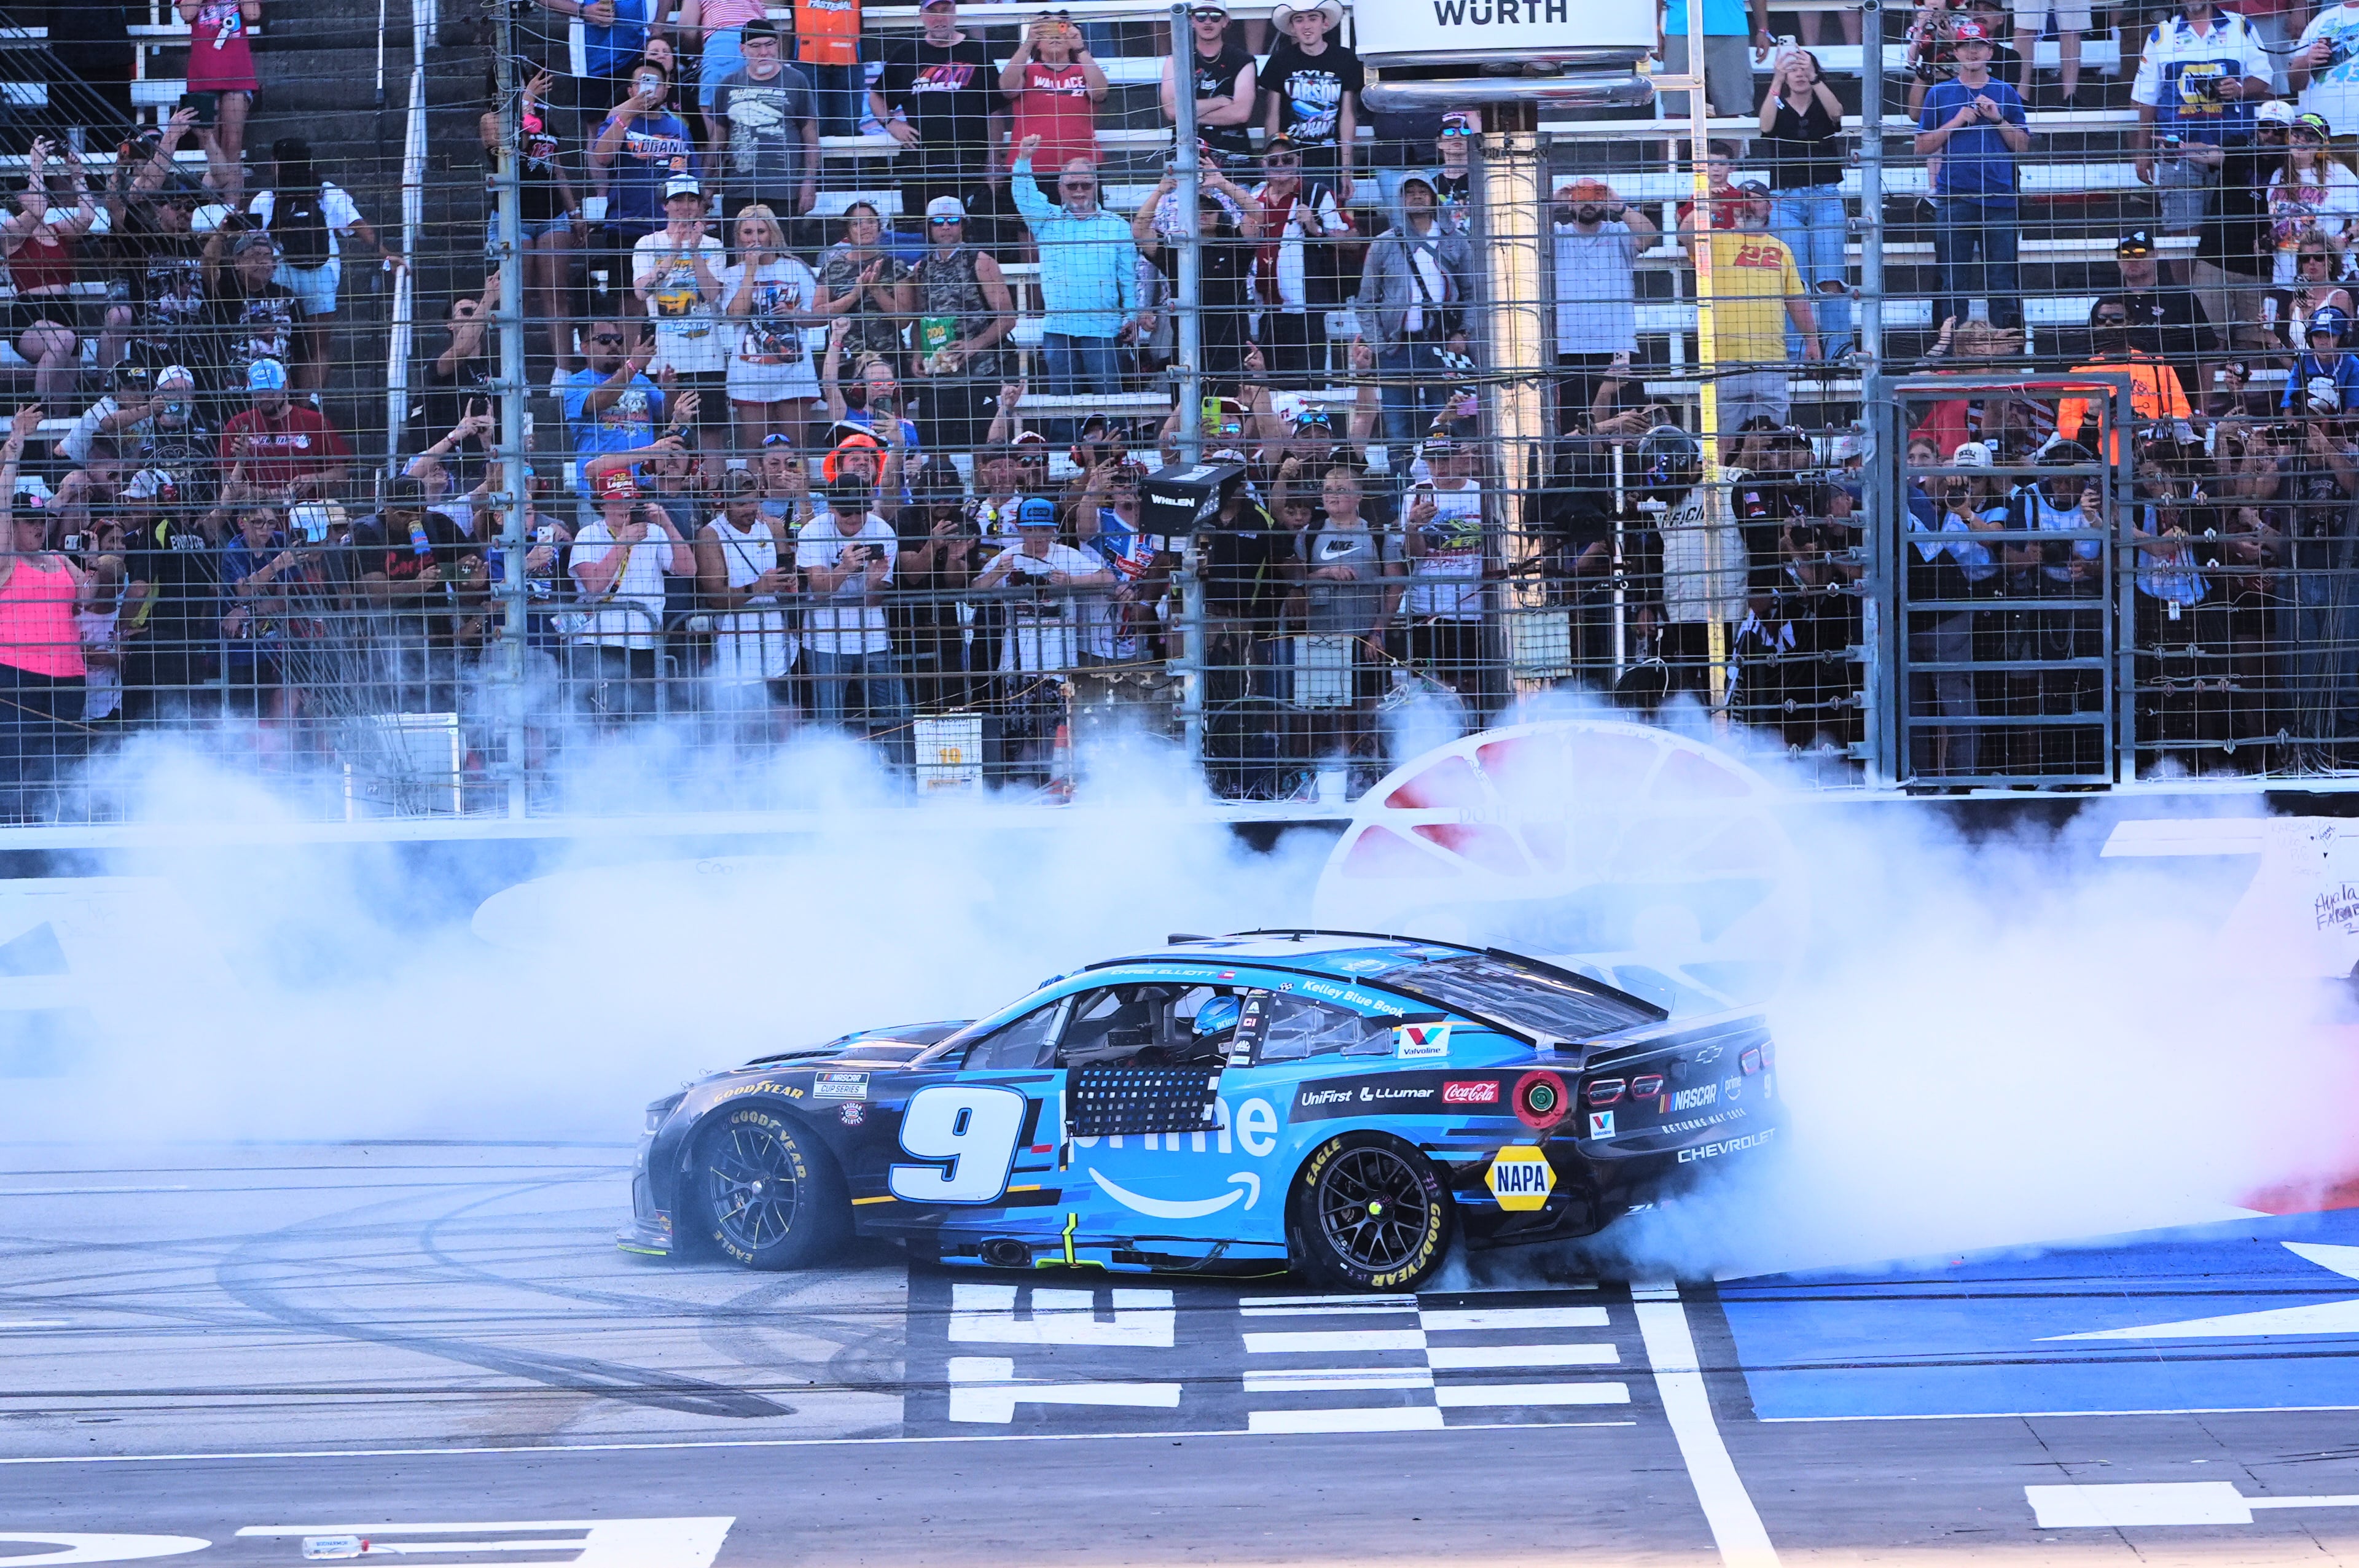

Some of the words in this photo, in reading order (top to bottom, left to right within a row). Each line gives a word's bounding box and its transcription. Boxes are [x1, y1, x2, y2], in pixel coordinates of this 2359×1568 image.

[1033, 75, 1086, 89] WALLACE
[1285, 80, 1341, 102] LARSON
[1734, 245, 1783, 267] 22
[1151, 493, 1195, 508] WHELEN
[1326, 539, 1355, 552] NIKE
[939, 747, 962, 764] 19
[1302, 980, 1344, 999] Kelley
[1343, 990, 1373, 1007] Blue
[1373, 999, 1406, 1018] Book
[714, 1080, 804, 1103] GOODYEAR
[1724, 1075, 1742, 1093] prime
[1763, 1074, 1772, 1099] 9
[1301, 1090, 1353, 1106] UniFirst
[1674, 1083, 1717, 1111] NASCAR
[1661, 1118, 1707, 1134] RETURNS
[731, 1110, 807, 1179] GOODYEAR
[889, 1083, 1028, 1205] 9
[1678, 1128, 1776, 1163] CHEVROLET
[1305, 1137, 1342, 1187] EAGLE
[1497, 1164, 1546, 1192] NAPA
[713, 1229, 754, 1264] EAGLE
[1371, 1203, 1441, 1287] GOODYEAR
